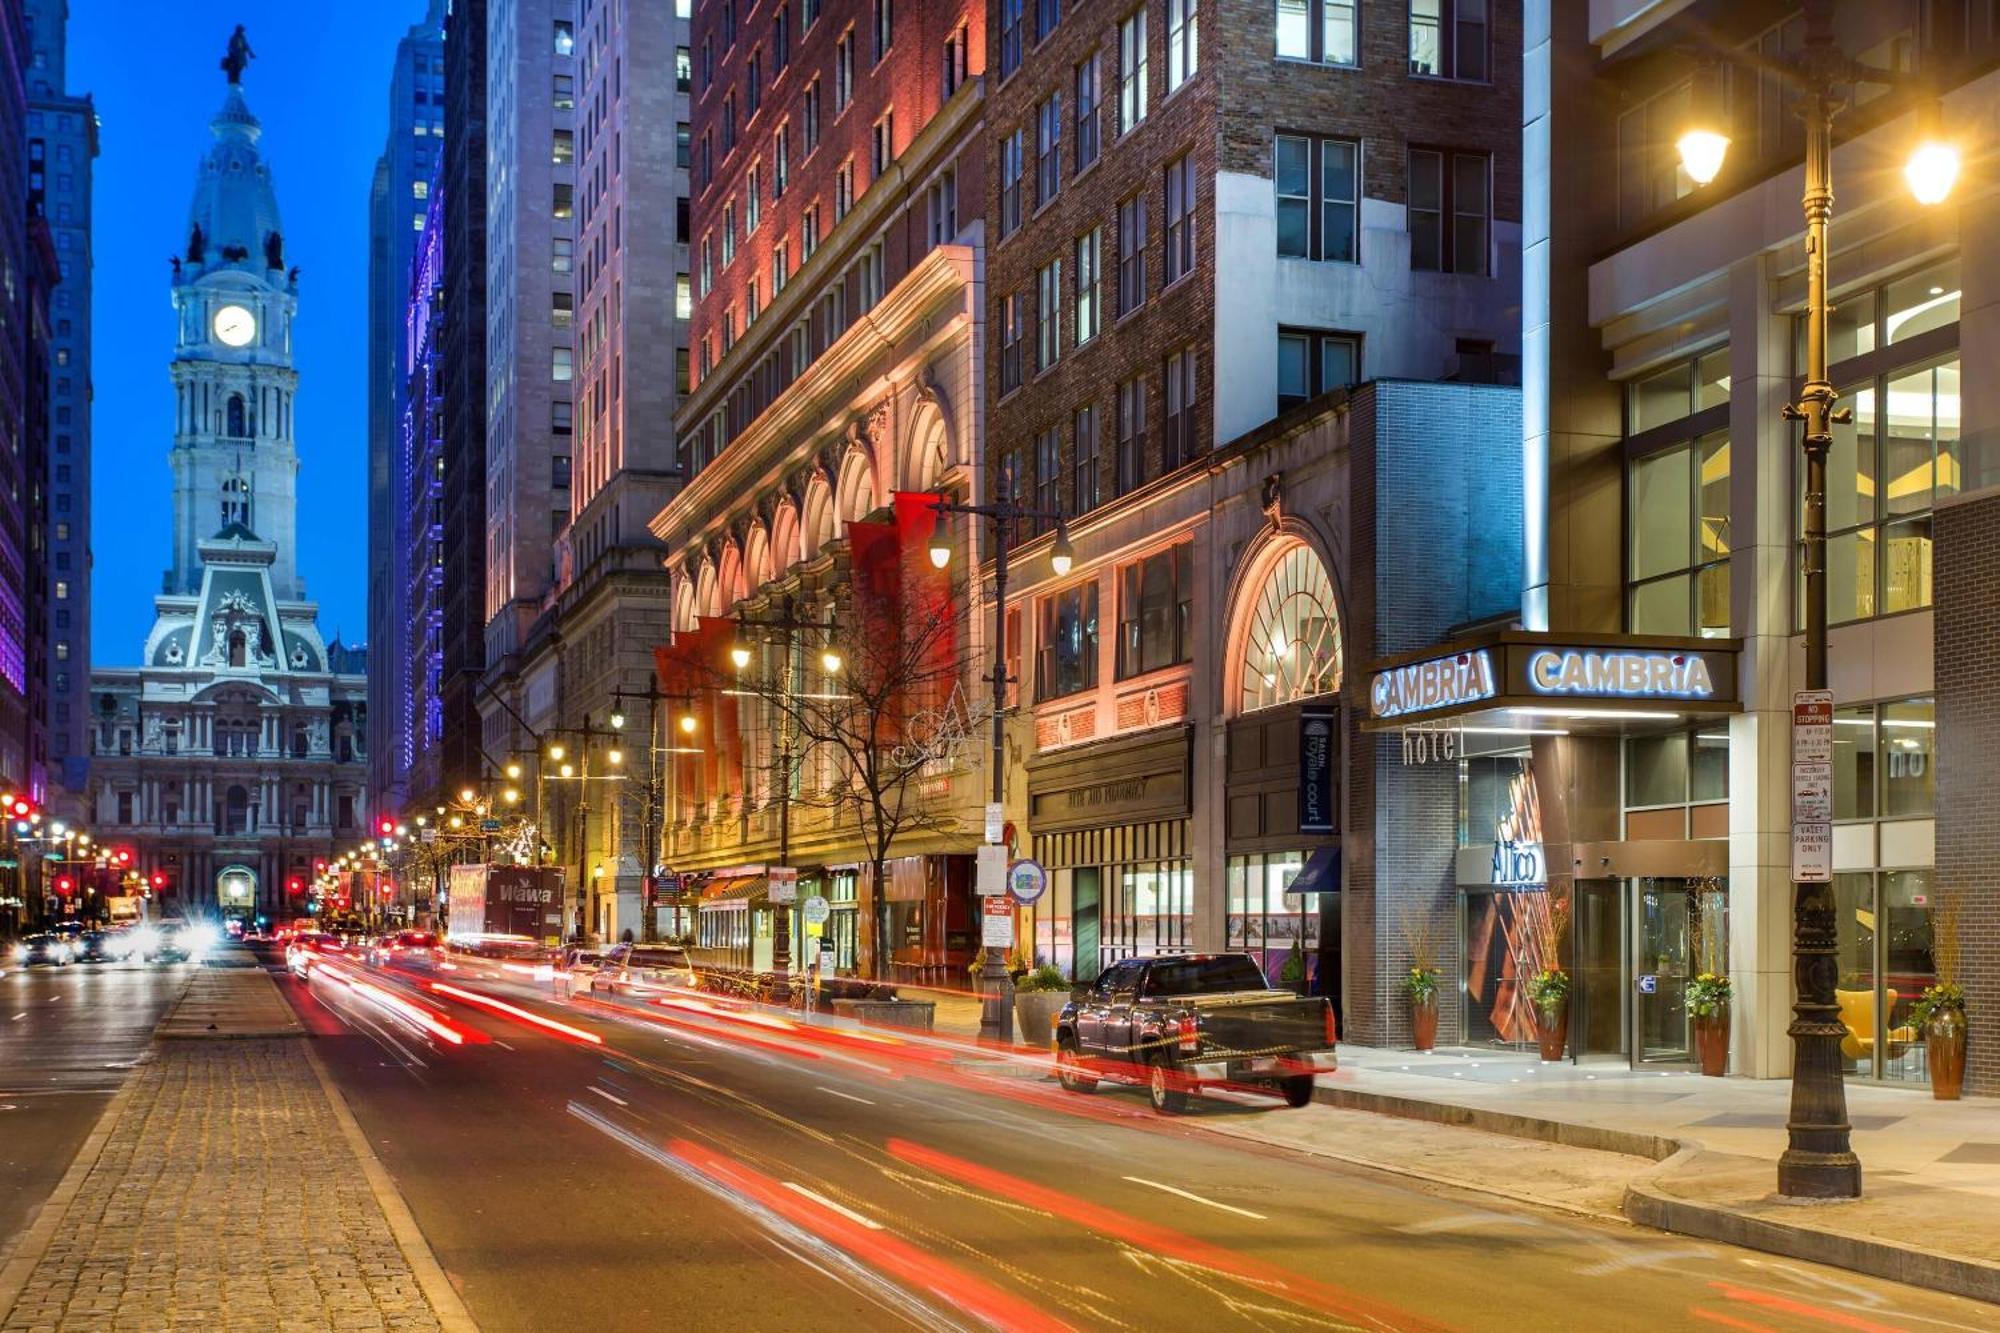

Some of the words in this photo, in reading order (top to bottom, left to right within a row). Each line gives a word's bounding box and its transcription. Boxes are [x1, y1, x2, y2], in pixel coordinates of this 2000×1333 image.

[1307, 782, 1321, 822] court
[1795, 835, 1829, 844] PARKING
[1802, 845, 1822, 853] ONLY
[500, 885, 552, 903] Wawa
